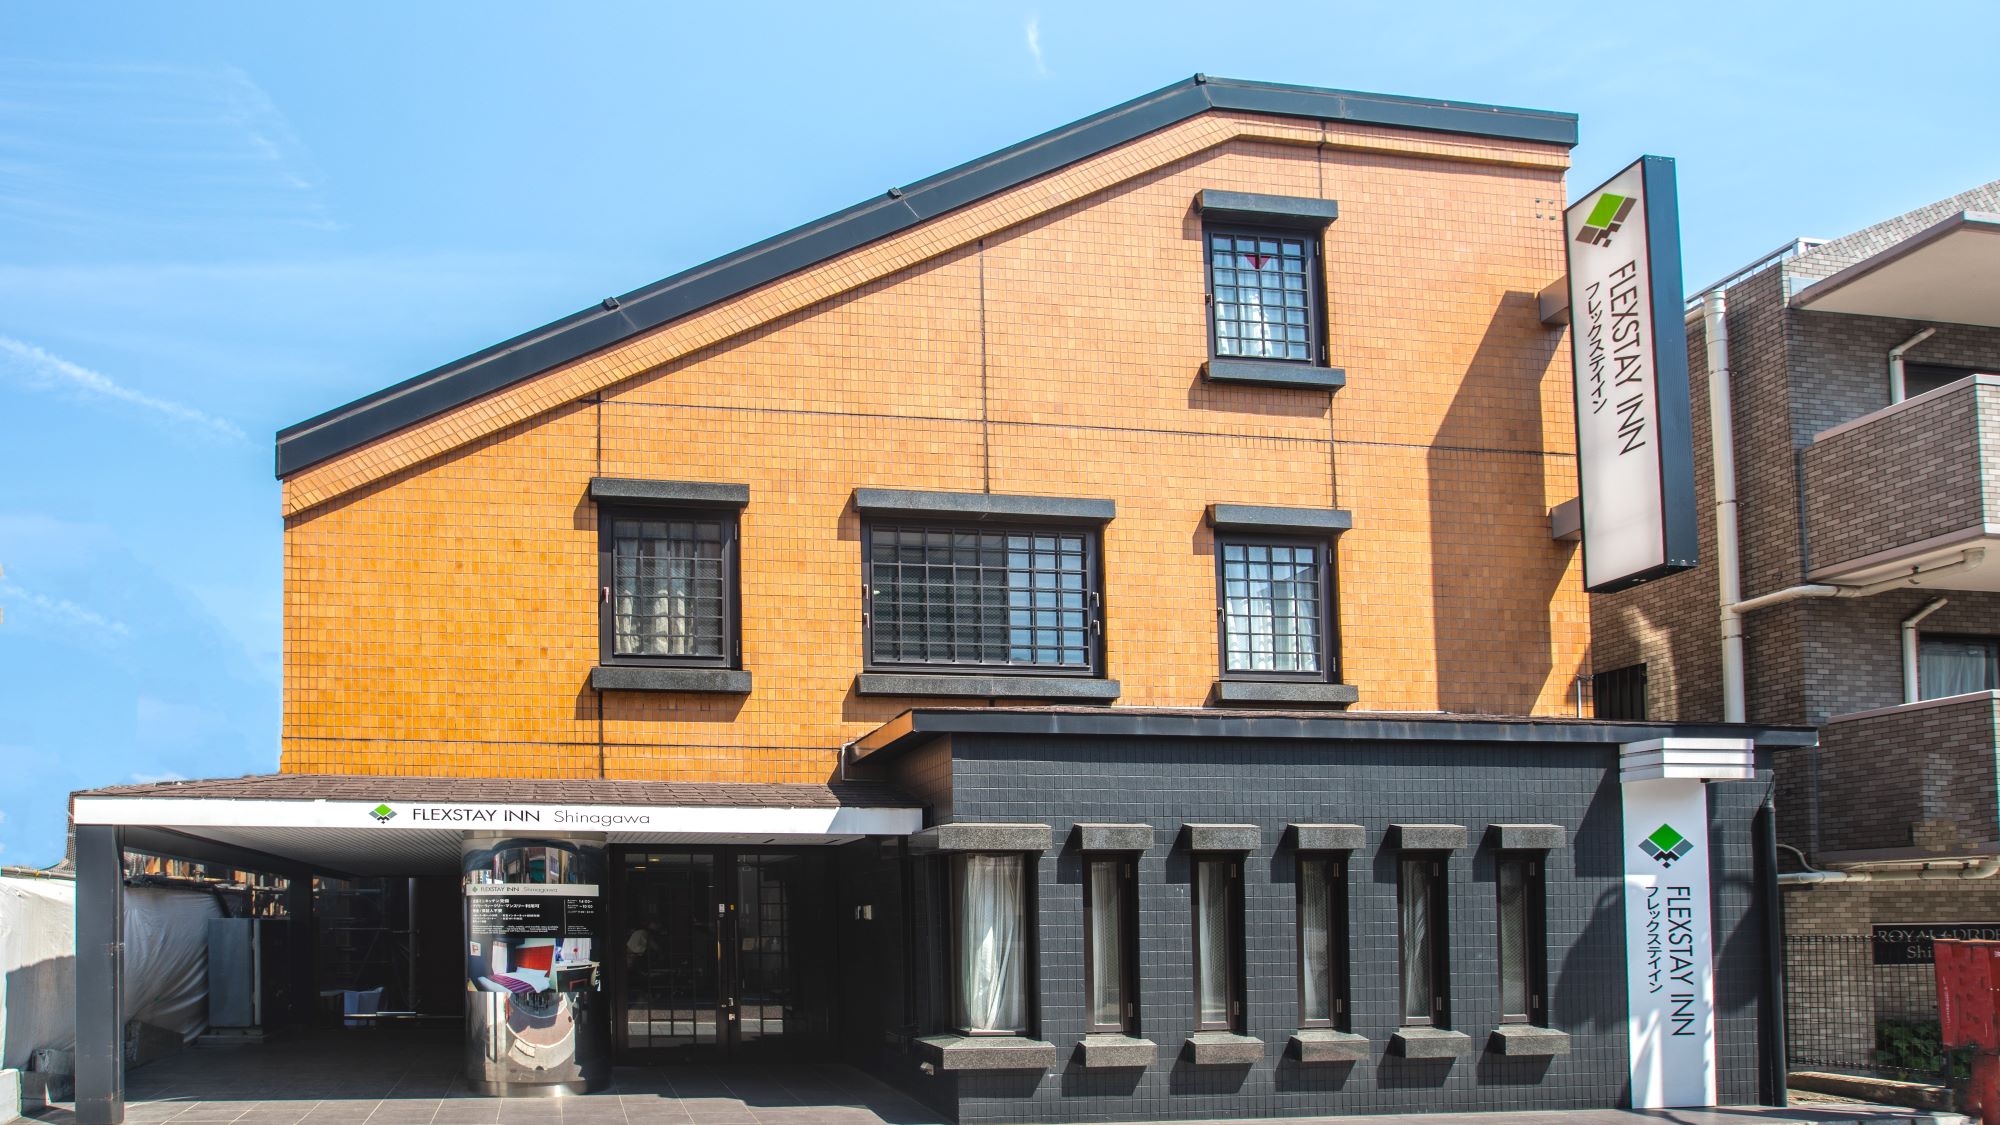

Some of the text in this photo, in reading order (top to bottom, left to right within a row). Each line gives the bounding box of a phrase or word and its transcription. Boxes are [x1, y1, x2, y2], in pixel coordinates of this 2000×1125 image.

[1585, 281, 1607, 414] フレックステイイン
[1608, 259, 1646, 456] FLEXSTAY INN
[412, 807, 650, 828] FLEXSTAY INN Shinagawa
[1645, 886, 1663, 994] フレックステイイン
[1666, 886, 1696, 1036] FLEXSTAY INN
[1877, 929, 1936, 943] ROYAL
